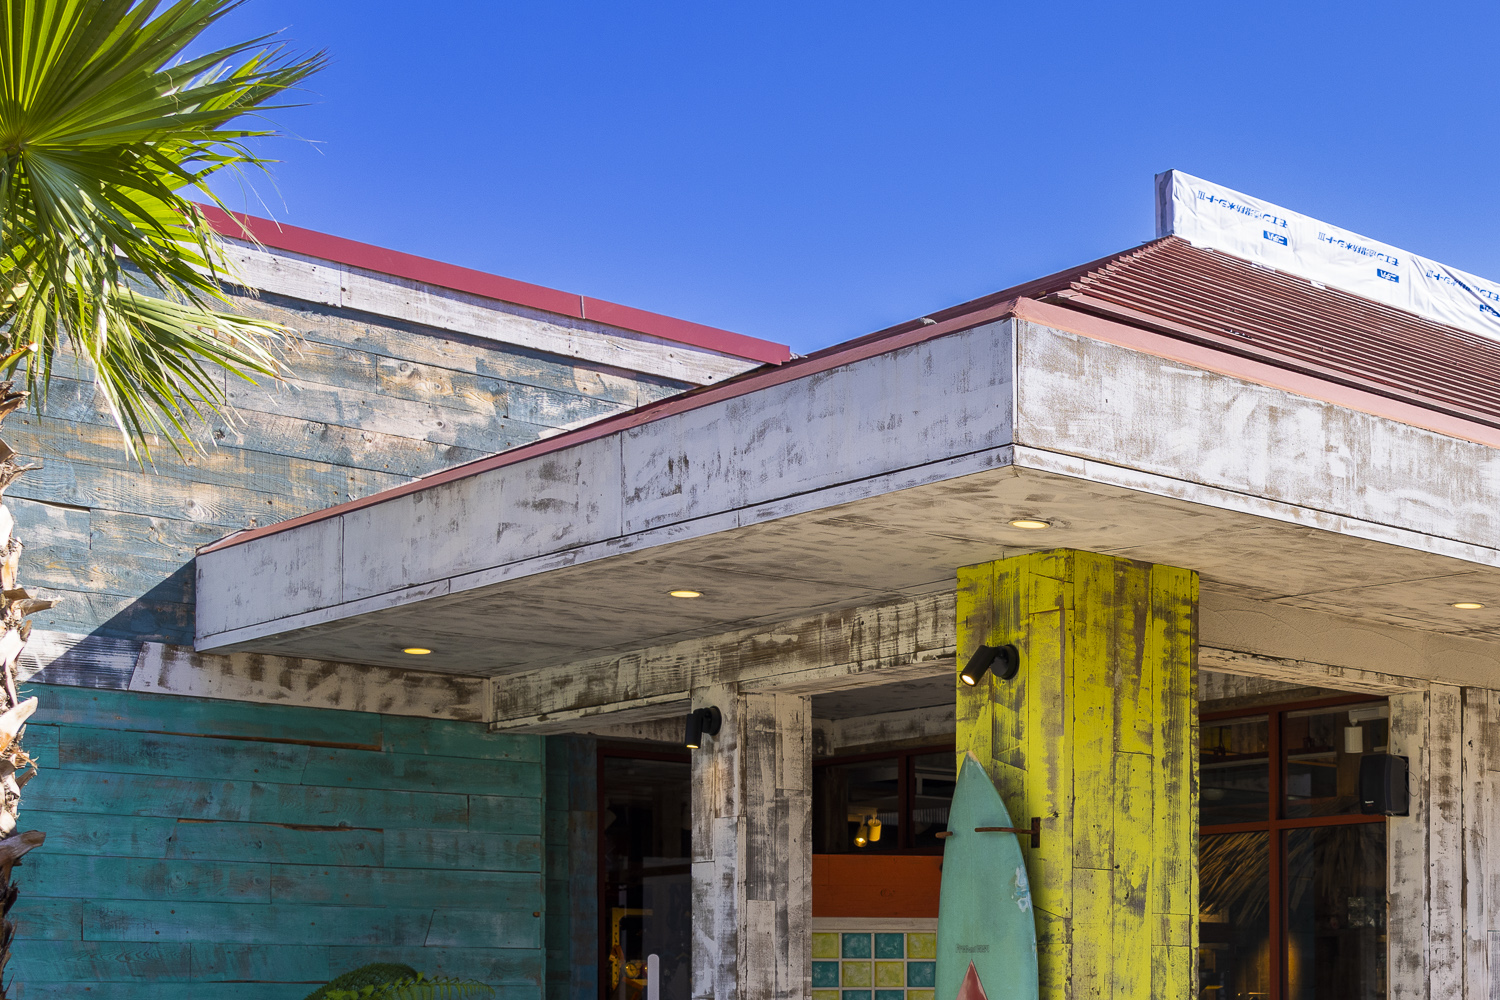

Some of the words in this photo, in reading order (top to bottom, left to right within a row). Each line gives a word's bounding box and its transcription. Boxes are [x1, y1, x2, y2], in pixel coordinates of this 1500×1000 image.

[1263, 230, 1288, 246] ニチハ
[1376, 268, 1400, 283] ニチハ
